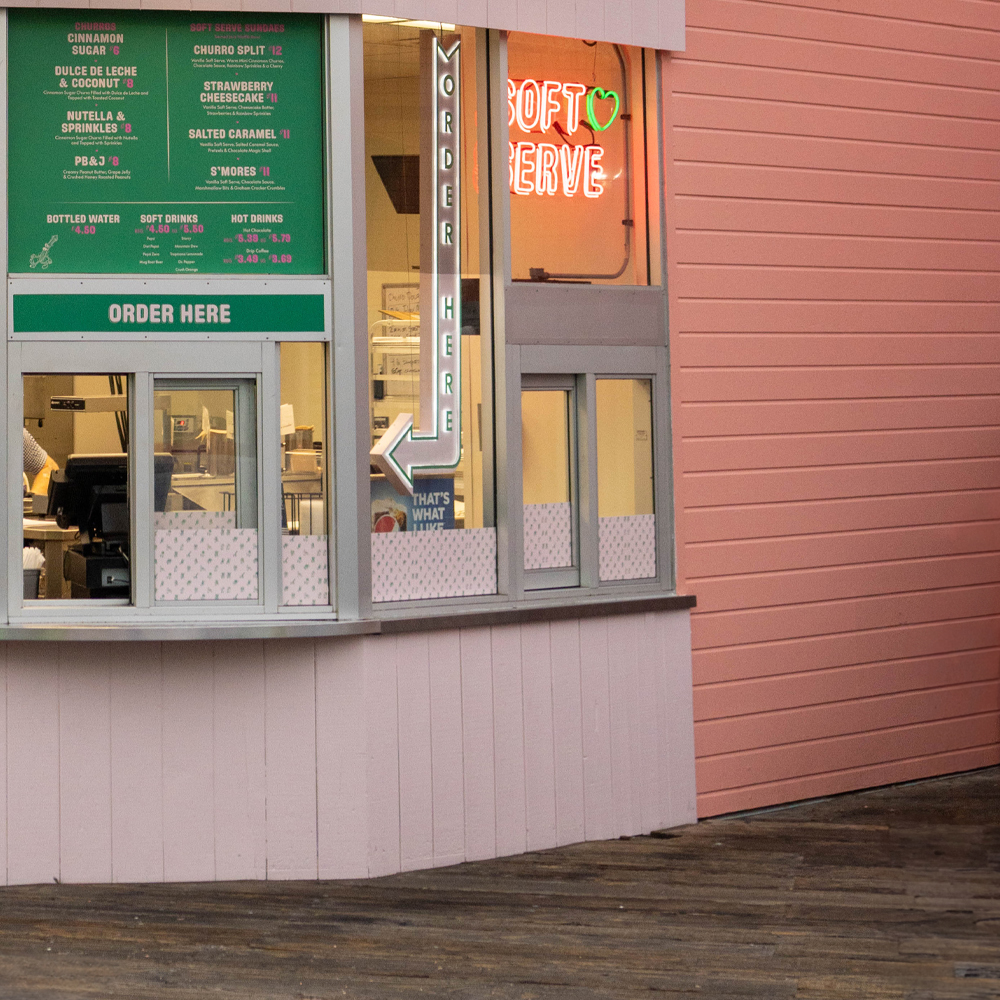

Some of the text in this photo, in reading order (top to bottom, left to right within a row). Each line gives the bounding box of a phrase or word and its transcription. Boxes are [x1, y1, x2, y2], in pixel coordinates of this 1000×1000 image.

[75, 22, 116, 31] CHURROS
[190, 23, 285, 33] SOFT SERVE SUNDAES
[67, 33, 124, 43] CINNAMON
[72, 45, 106, 55] SUGAR
[193, 45, 235, 55] CHURRO
[237, 45, 265, 55] SPLIT
[55, 66, 137, 76] DULCE DE LECHE
[59, 78, 68, 88] &
[71, 78, 120, 88] COCONUT
[204, 81, 273, 91] STRAWBERRY
[200, 92, 264, 103] CHEESECAKE
[67, 111, 126, 121] NUTELLA &
[61, 123, 118, 133] SPRINKLES
[188, 129, 226, 139] SALTED
[228, 129, 277, 139] CARAMEL
[75, 156, 105, 166] PB&J
[210, 166, 256, 177] S'MORES
[509, 141, 604, 198] ERVE
[47, 214, 120, 223] BOTTLED WATER
[140, 214, 198, 223] SOFT DRINKS
[231, 214, 283, 223] HOT DRINKS
[442, 73, 456, 432] ORDER HERE
[108, 303, 231, 323] ORDER HERE
[412, 491, 450, 506] THAT'S
[412, 507, 446, 521] WHAT
